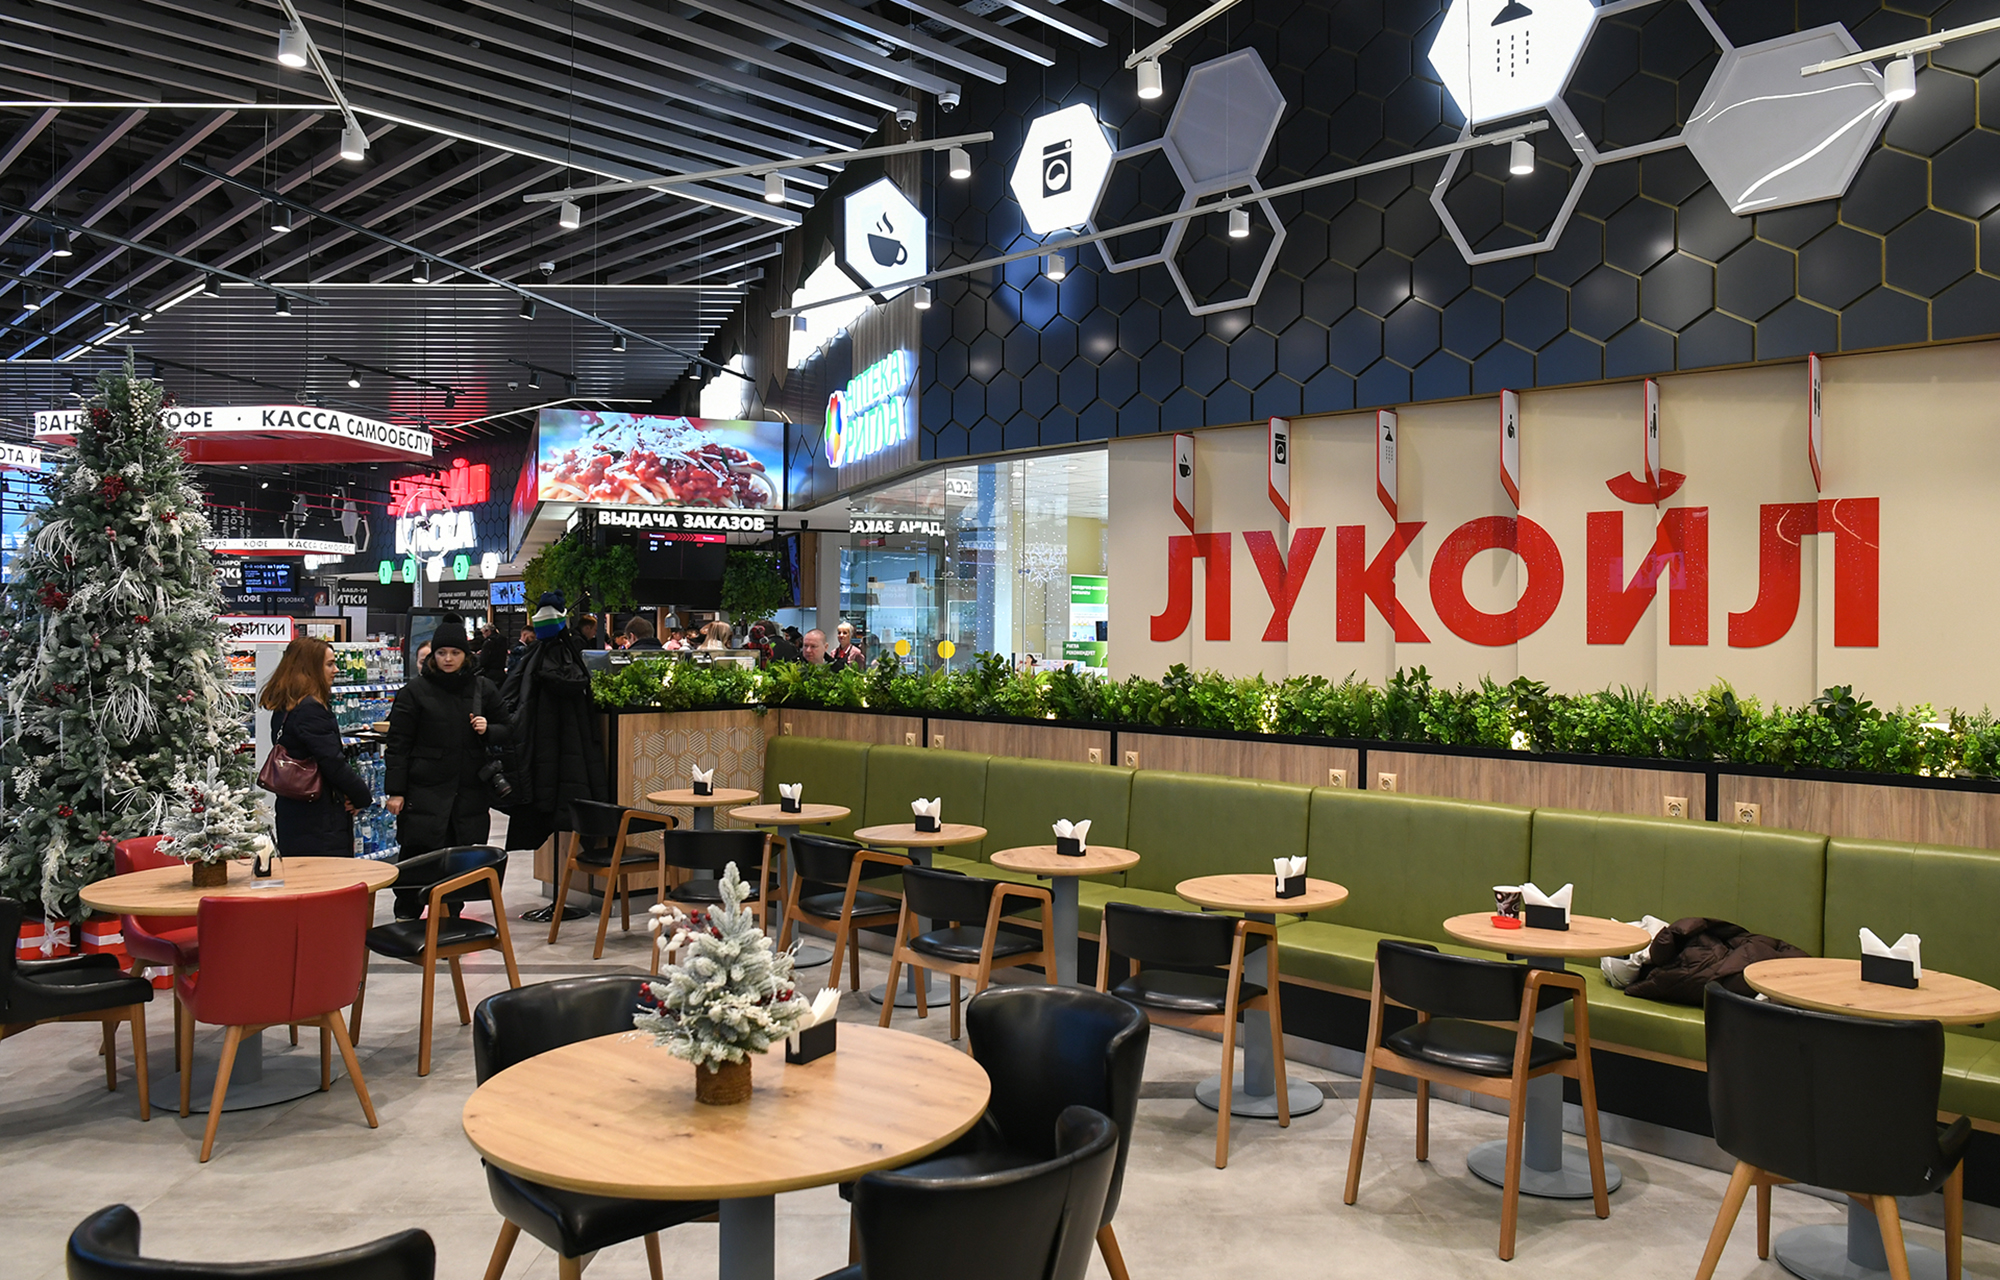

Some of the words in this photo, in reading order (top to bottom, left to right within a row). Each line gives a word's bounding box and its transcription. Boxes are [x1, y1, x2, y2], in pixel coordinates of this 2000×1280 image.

[845, 350, 906, 417] АПТЕКА
[37, 414, 77, 432] ВАН
[165, 411, 212, 429] ОФЕ
[262, 410, 340, 432] КАССА
[347, 418, 430, 452] САМООБСЛУ
[845, 396, 906, 463] РИГЛА
[598, 510, 678, 529] ВЫДАЧА
[682, 513, 765, 531] ЗАКАЗОВ
[243, 540, 268, 548] КОФЕ
[287, 541, 318, 549] КАССА
[1150, 468, 1880, 649] ЛУКОЙЛ
[382, 567, 386, 577] 1
[405, 565, 410, 576] 2
[457, 562, 462, 573] 3
[237, 594, 261, 603] КОФЕ
[337, 594, 368, 604] ИТКИ
